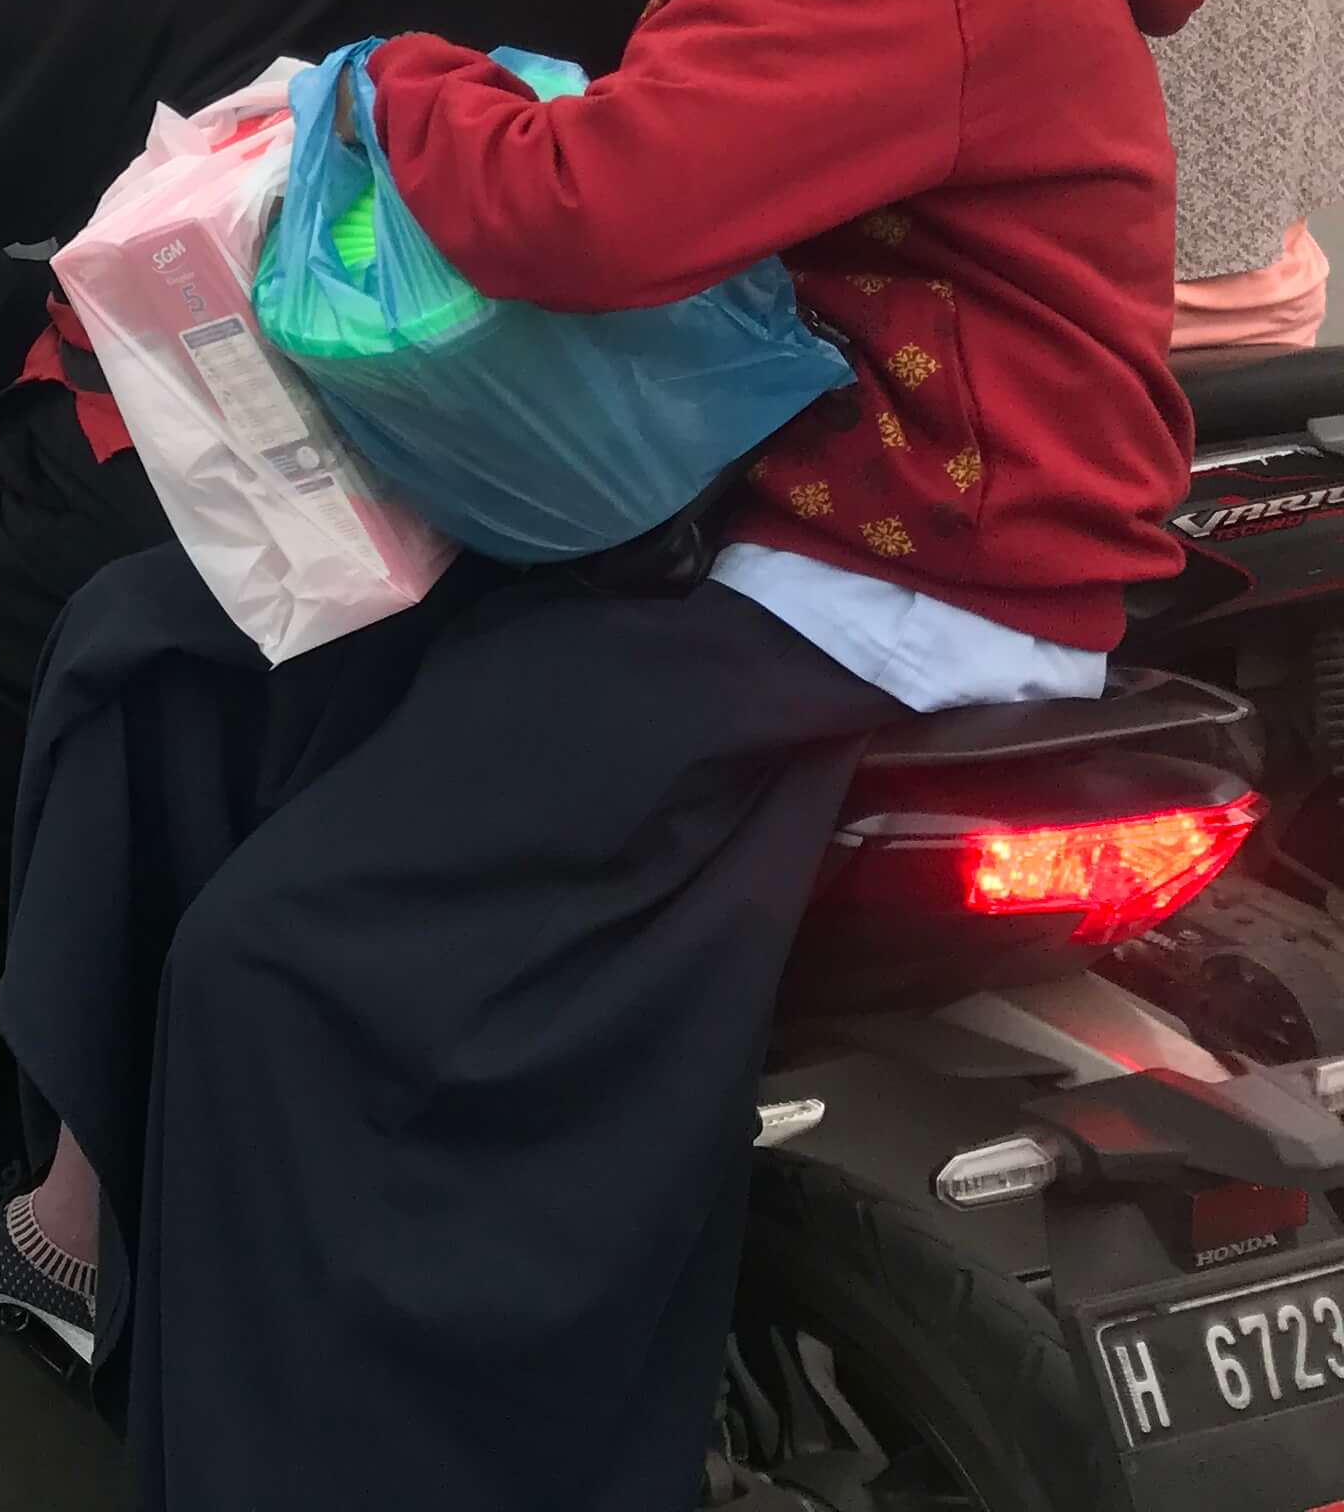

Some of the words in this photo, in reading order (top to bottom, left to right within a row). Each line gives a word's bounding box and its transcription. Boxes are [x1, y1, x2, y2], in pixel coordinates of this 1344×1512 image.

[150, 239, 187, 271] SGM
[1194, 1232, 1278, 1268] HONDA
[1115, 1341, 1171, 1433] H
[1205, 1296, 1344, 1410] 6723
